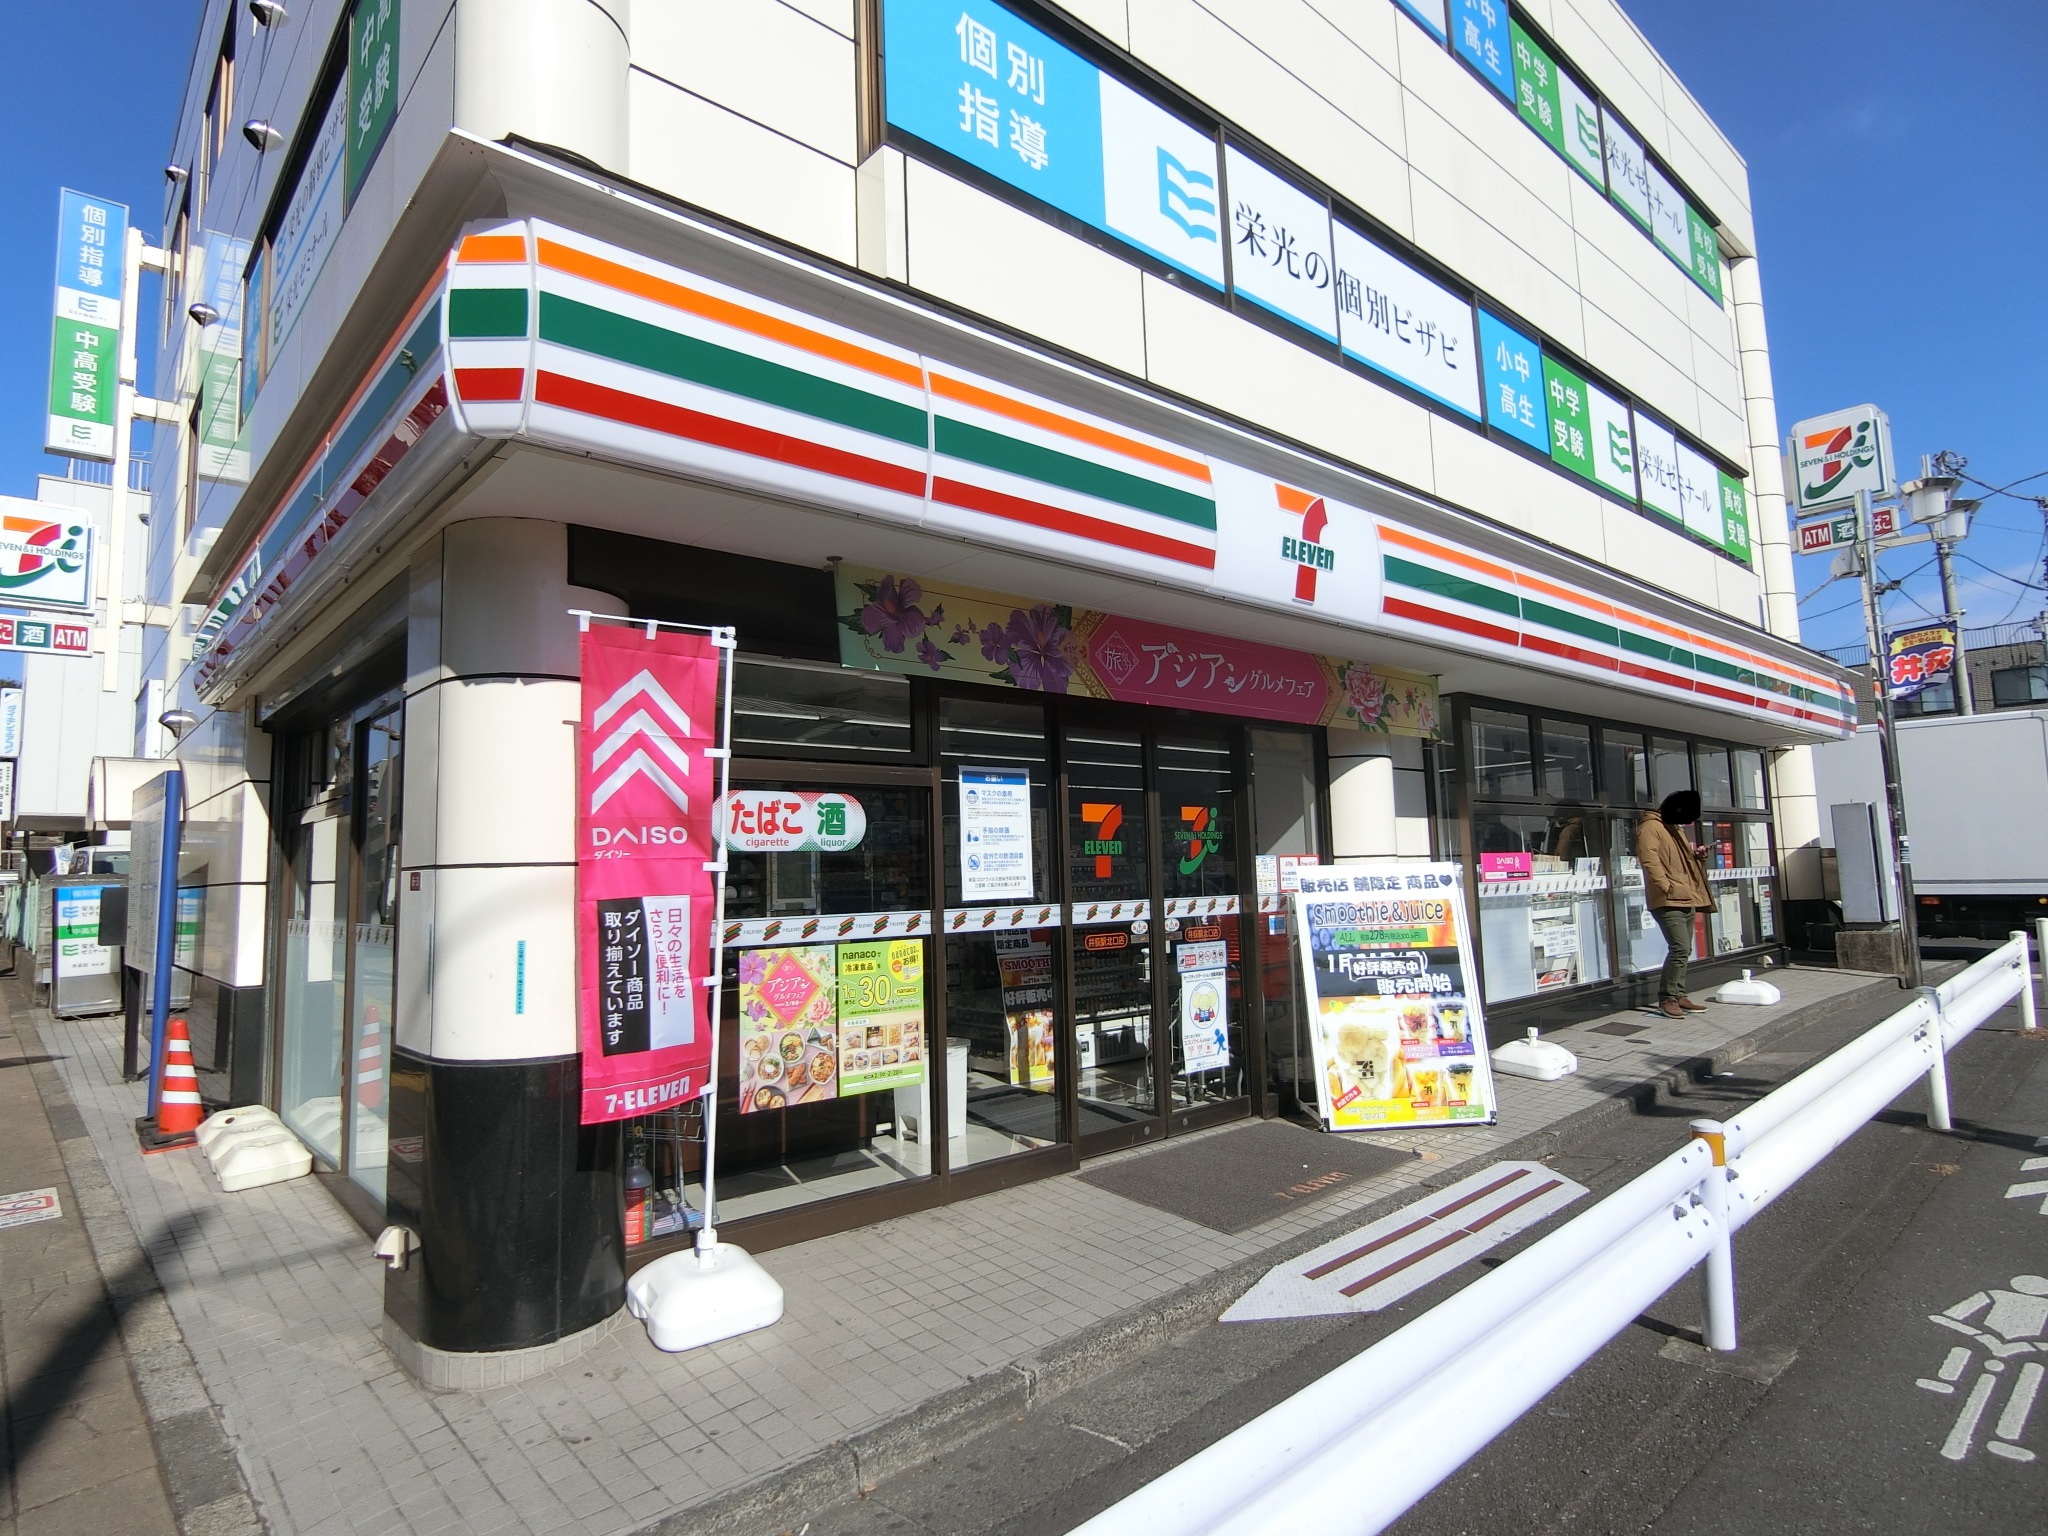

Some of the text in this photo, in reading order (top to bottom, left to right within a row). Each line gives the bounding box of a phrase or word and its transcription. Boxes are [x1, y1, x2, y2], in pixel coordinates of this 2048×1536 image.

[955, 11, 1045, 106] 個別
[1463, 16, 1502, 76] 高生
[1516, 41, 1548, 88] 中学
[1520, 78, 1553, 132] 受験
[958, 82, 1049, 171] 指導
[79, 204, 107, 287] 個別指導
[1235, 200, 1458, 370] 栄光の個別ビザビ
[70, 330, 99, 414] 中高受験
[1496, 341, 1530, 383] 小中
[1499, 383, 1536, 428] 高生
[1549, 378, 1580, 417] 中学
[1553, 418, 1585, 461] 受験
[1834, 444, 1875, 459] HOLDINGS
[1723, 486, 1744, 517] 高校
[1727, 519, 1747, 548] 受験
[1804, 527, 1830, 547] ATM
[1836, 522, 1856, 539] 酒
[36, 547, 85, 560] HOLDINGS
[23, 625, 46, 644] 酒
[55, 629, 87, 647] ATM
[731, 799, 804, 835] たばこ
[817, 801, 846, 836] 酒
[591, 826, 688, 847] DAISO
[745, 838, 790, 848] cigarette
[820, 838, 847, 848] liquor
[1197, 831, 1223, 840] HOLDINGS
[593, 850, 631, 861] ダイソー
[996, 938, 1030, 950] 限定商品
[1340, 932, 1356, 942] ALL
[624, 907, 644, 1011] ダイソー商品
[667, 908, 686, 999] 日々の生活を
[1004, 957, 1052, 971] SMOOTH
[1353, 961, 1419, 976] 好評発売中
[604, 911, 624, 1046] 取り揃えています
[767, 975, 811, 994] アジアン
[858, 974, 892, 1008] 30
[1376, 972, 1453, 995] 販売開始
